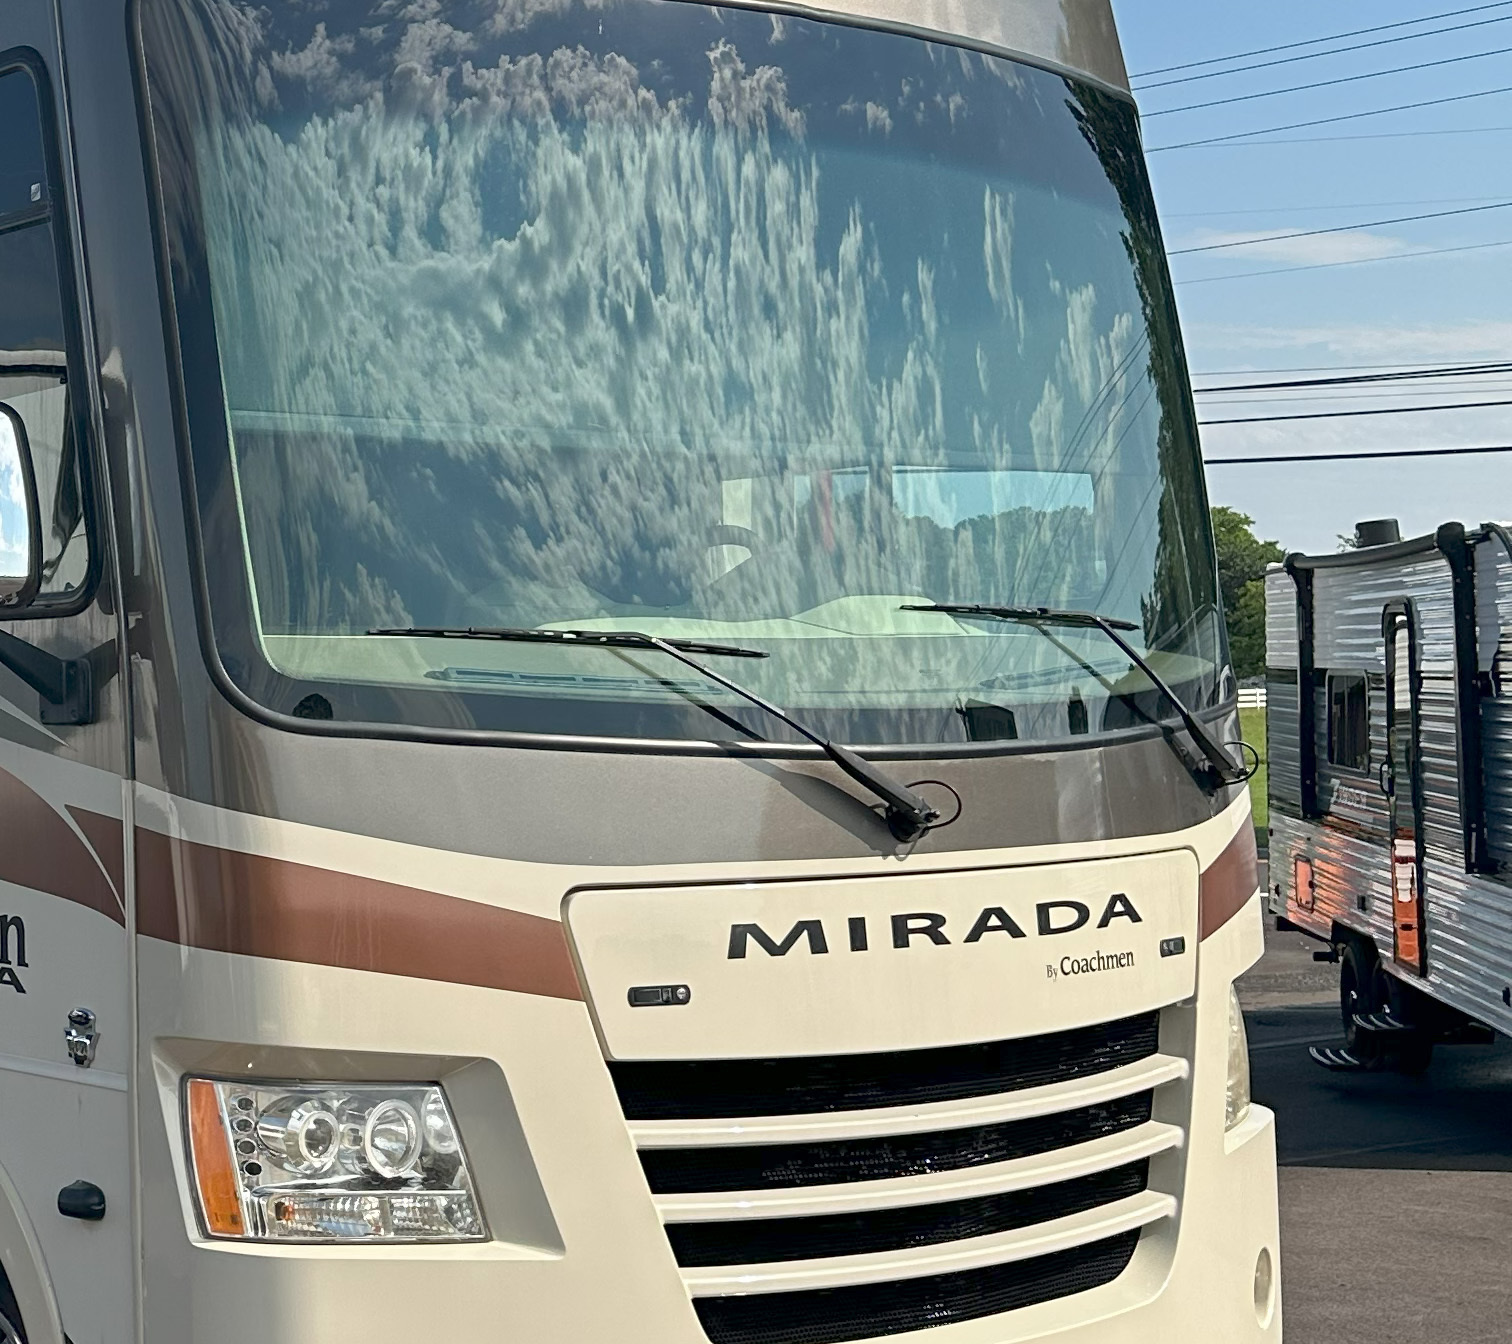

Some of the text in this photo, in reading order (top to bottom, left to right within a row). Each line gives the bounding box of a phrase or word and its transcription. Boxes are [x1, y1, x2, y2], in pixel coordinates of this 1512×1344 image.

[727, 892, 1143, 959] MIRADA
[1046, 949, 1135, 982] By Coachmen
